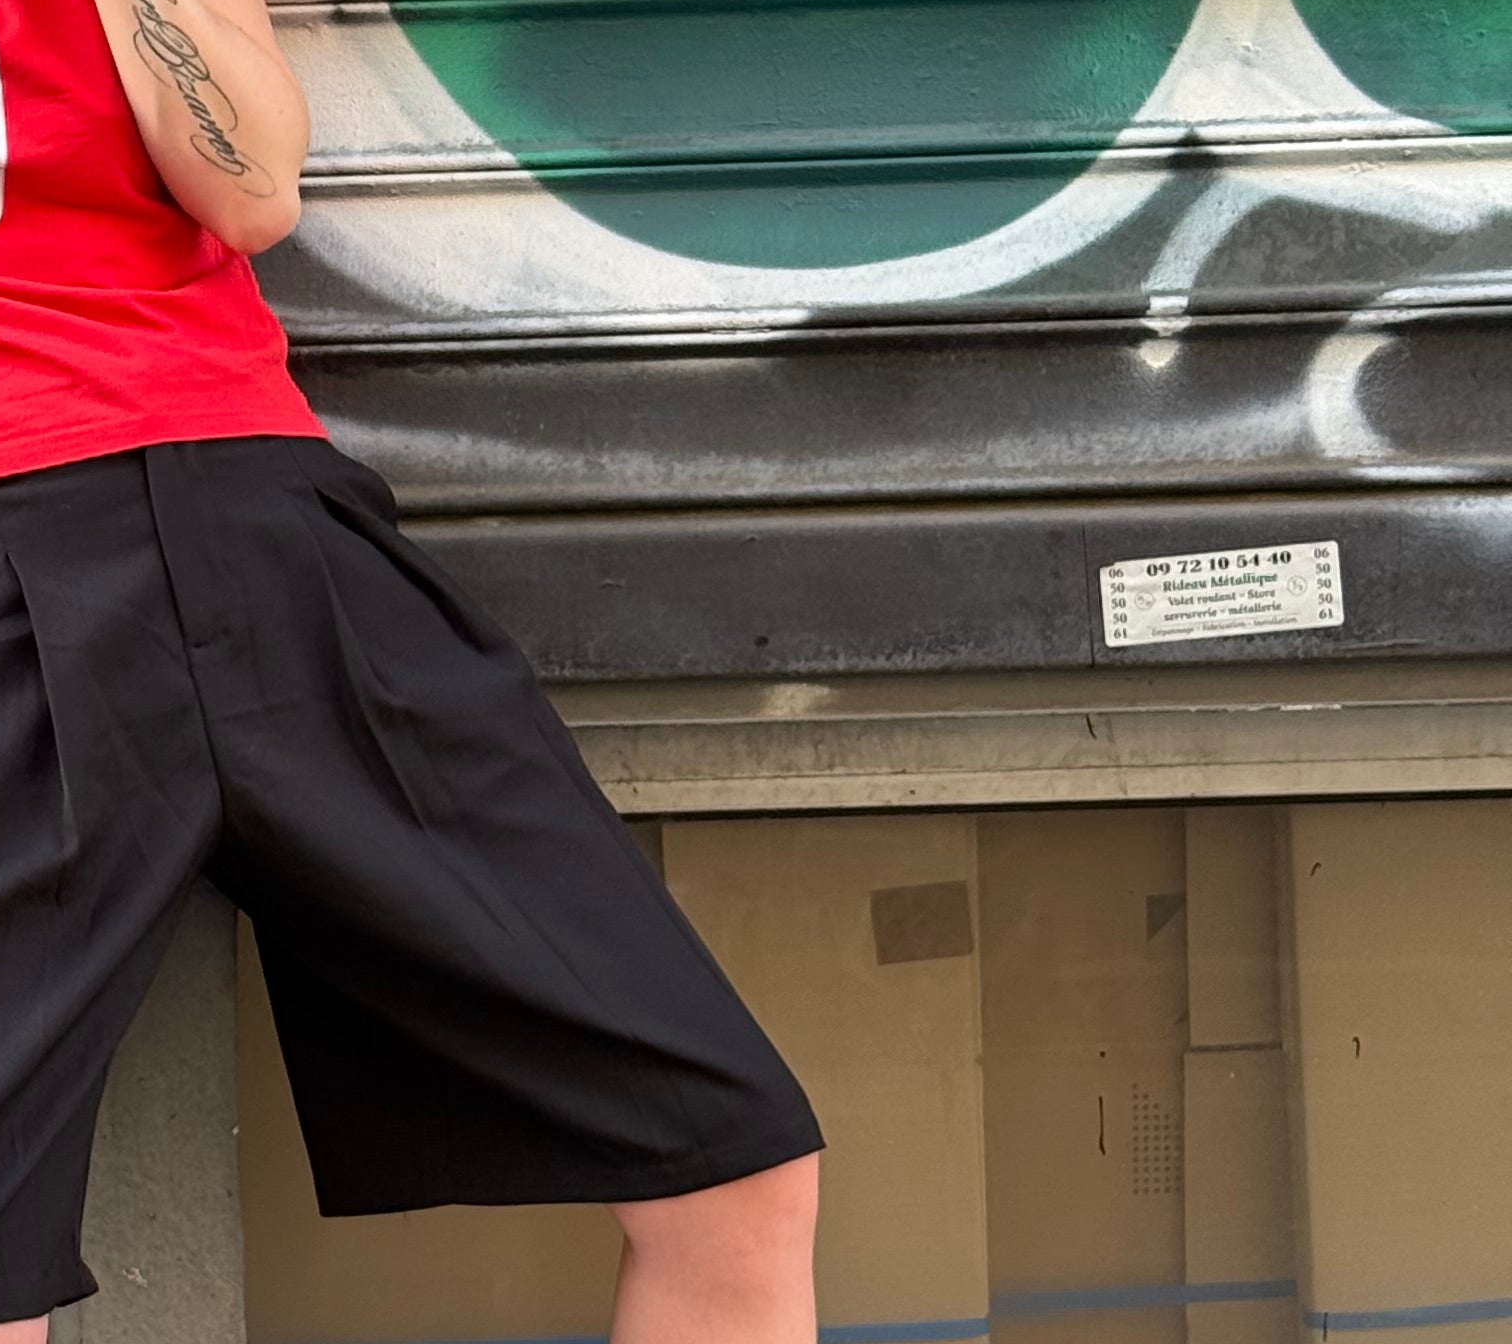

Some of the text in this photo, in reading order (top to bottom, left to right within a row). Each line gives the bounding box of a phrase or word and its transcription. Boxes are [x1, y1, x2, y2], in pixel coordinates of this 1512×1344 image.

[1314, 546, 1330, 559] 06
[1146, 550, 1291, 577] 09 72 10 54 40
[1316, 562, 1331, 574] 50
[1108, 568, 1124, 578] 06
[1110, 582, 1125, 594] 50
[1163, 572, 1278, 592] Rideau Métallique
[1317, 578, 1332, 590] 50
[1111, 597, 1126, 609] 50
[1319, 593, 1333, 605] 50
[1113, 612, 1128, 624] 50
[1319, 608, 1334, 620] 61
[1113, 627, 1127, 639] 61
